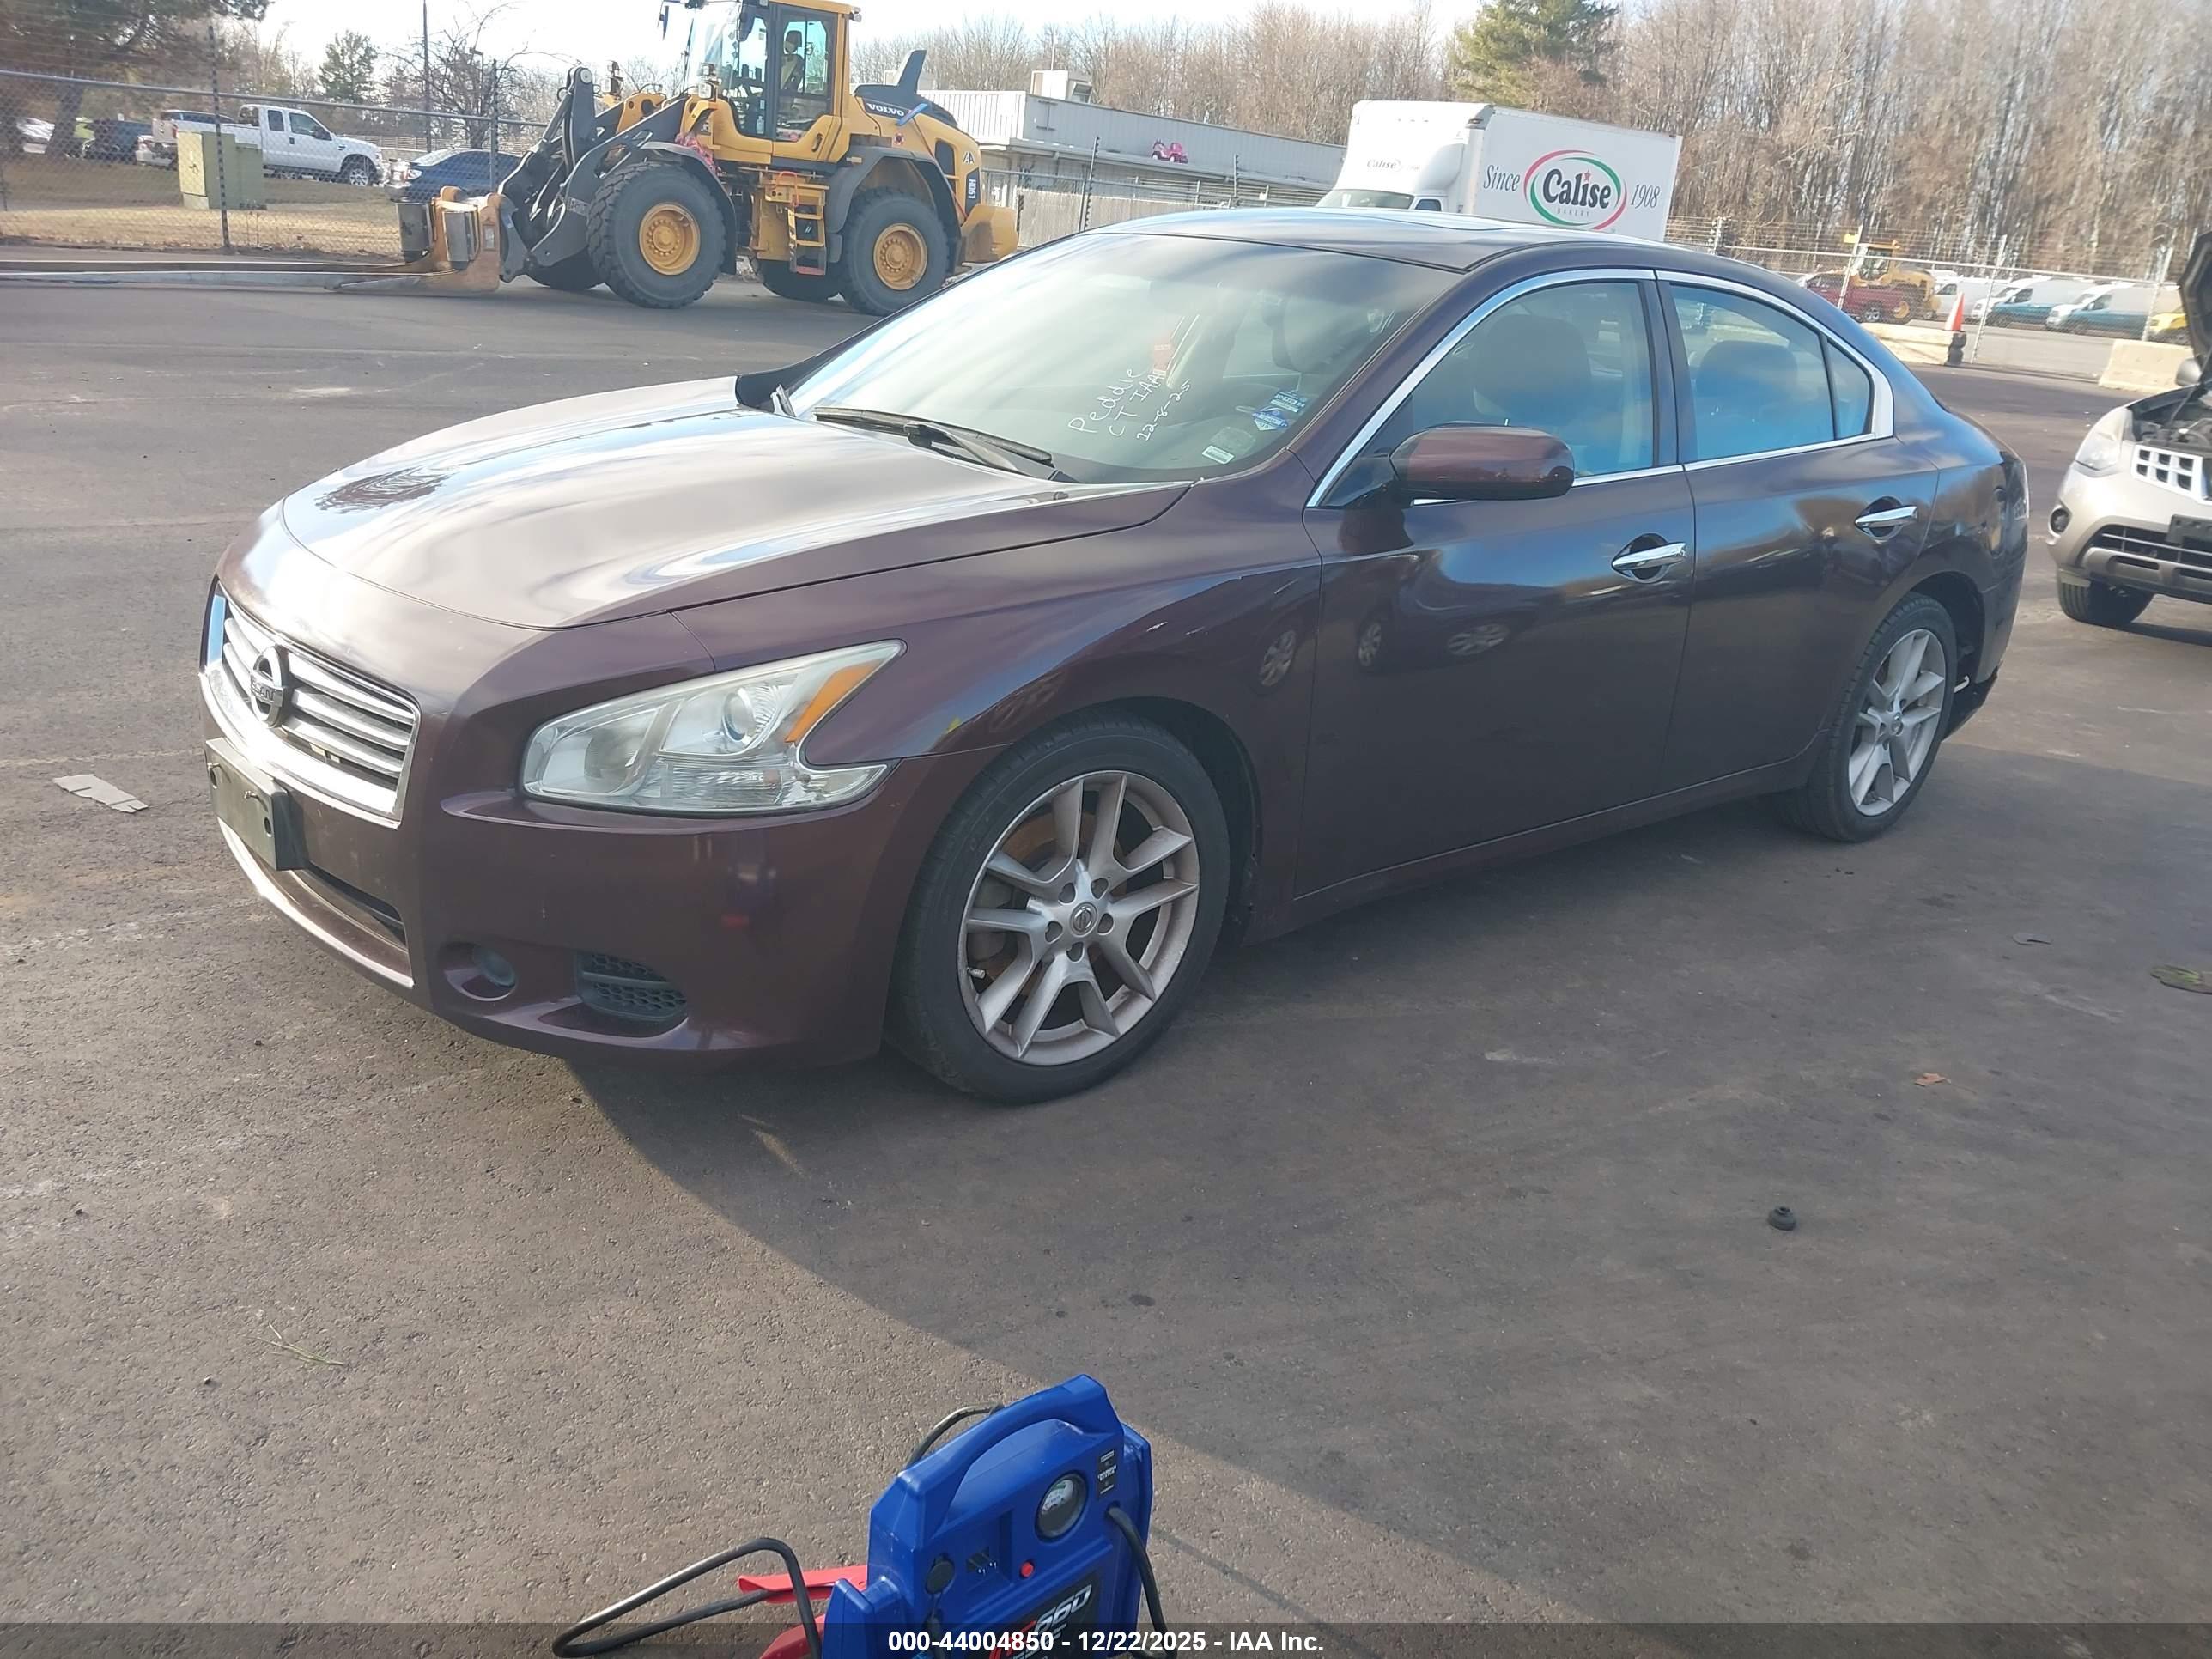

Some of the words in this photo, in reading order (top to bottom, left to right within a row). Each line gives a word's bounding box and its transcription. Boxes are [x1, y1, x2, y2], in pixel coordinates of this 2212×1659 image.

[866, 103, 904, 116] VOLVO
[1483, 165, 1521, 192] Since
[1542, 168, 1612, 209] Calise
[1631, 184, 1661, 209] 1908
[1067, 368, 1147, 434] Peddle
[1109, 405, 1139, 437] CT
